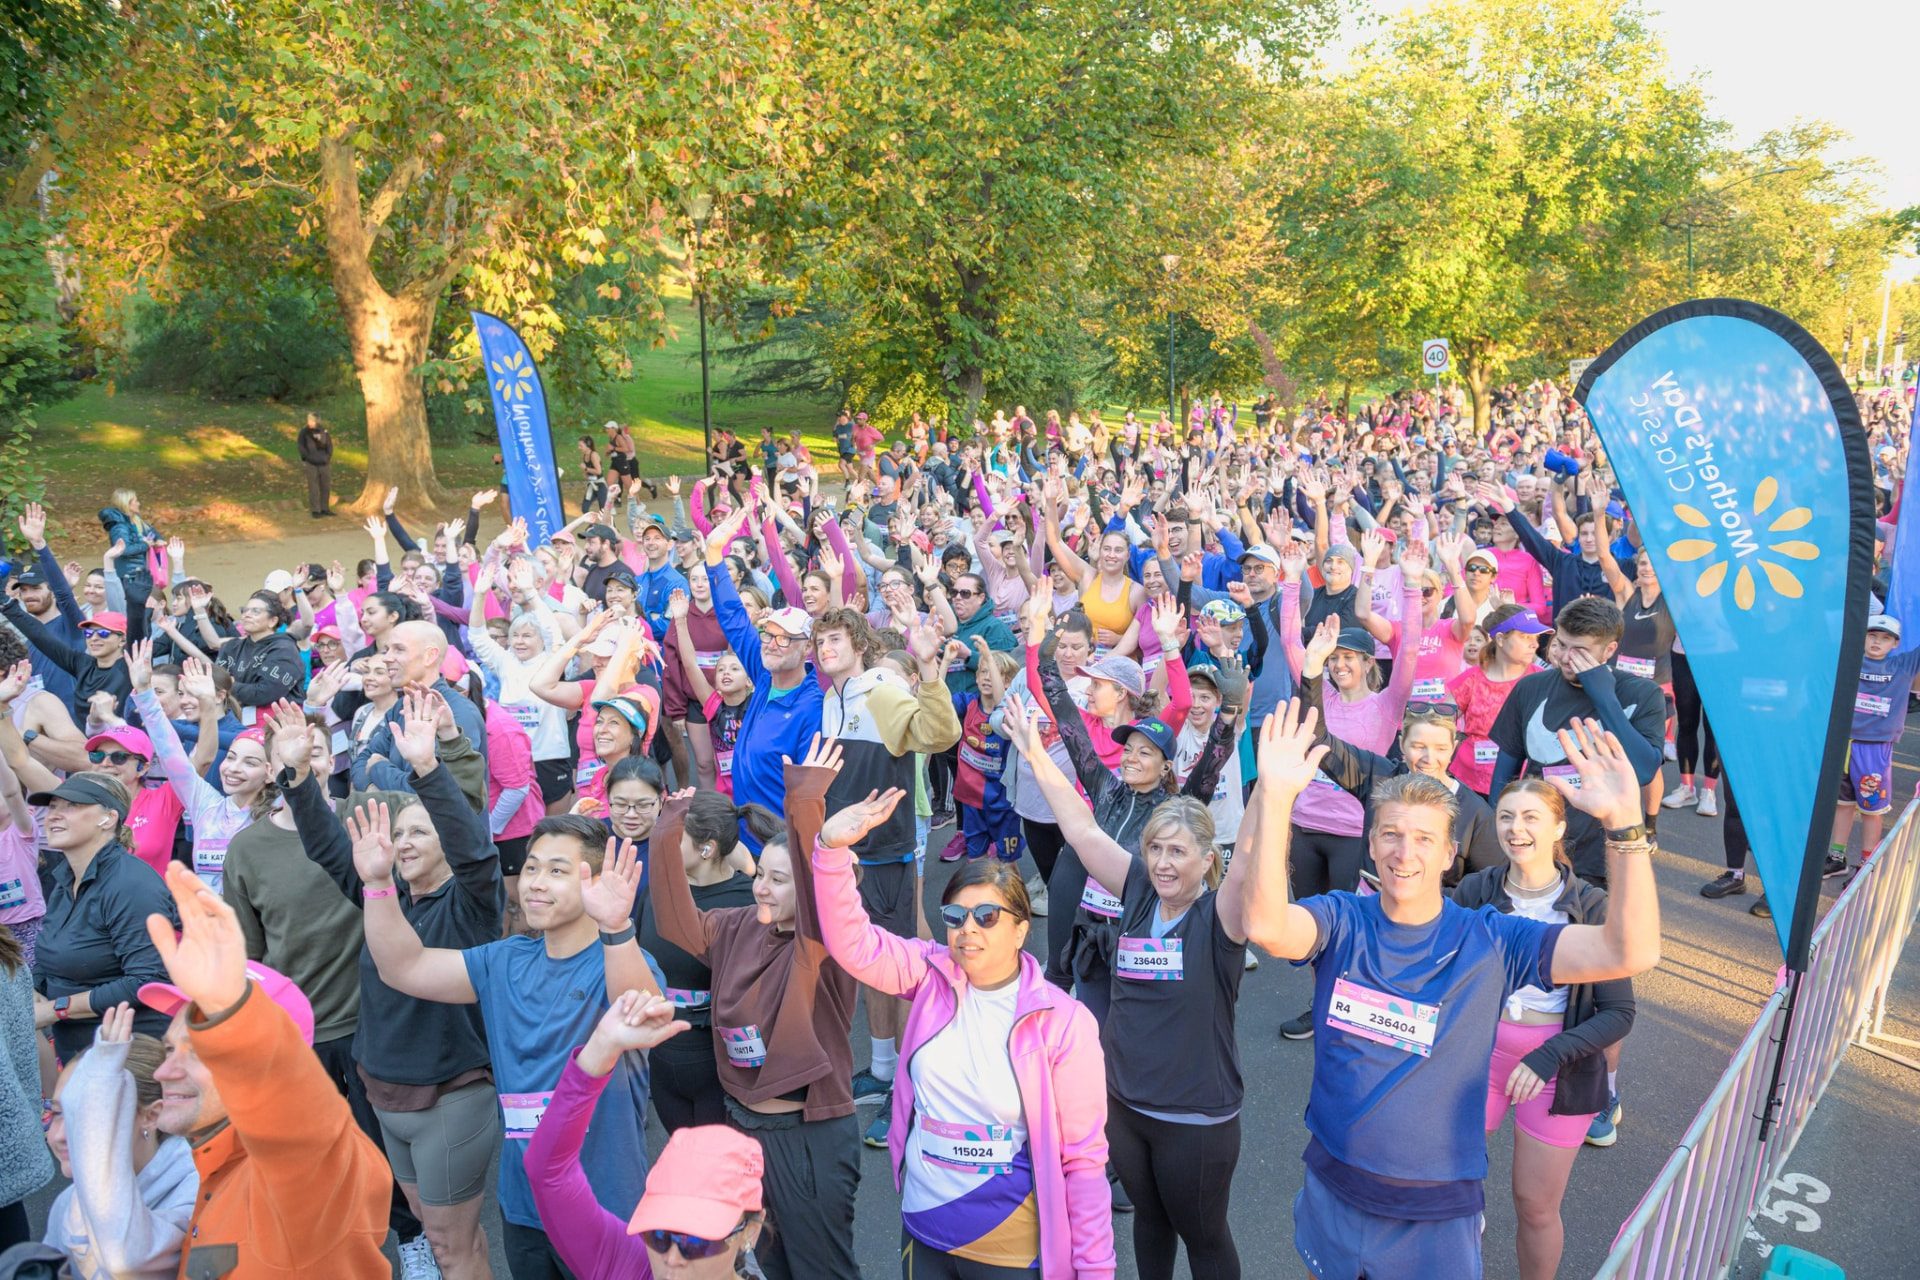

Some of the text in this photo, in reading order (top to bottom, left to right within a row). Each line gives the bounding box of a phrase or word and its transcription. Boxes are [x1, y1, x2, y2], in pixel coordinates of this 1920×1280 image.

[1428, 351, 1445, 362] 40
[1860, 673, 1893, 682] ECRAFT
[1003, 837, 1018, 854] 19
[1102, 898, 1123, 909] 2327
[1133, 957, 1169, 965] 236403
[1335, 1001, 1416, 1034] R4 236404
[953, 1146, 993, 1157] 115024
